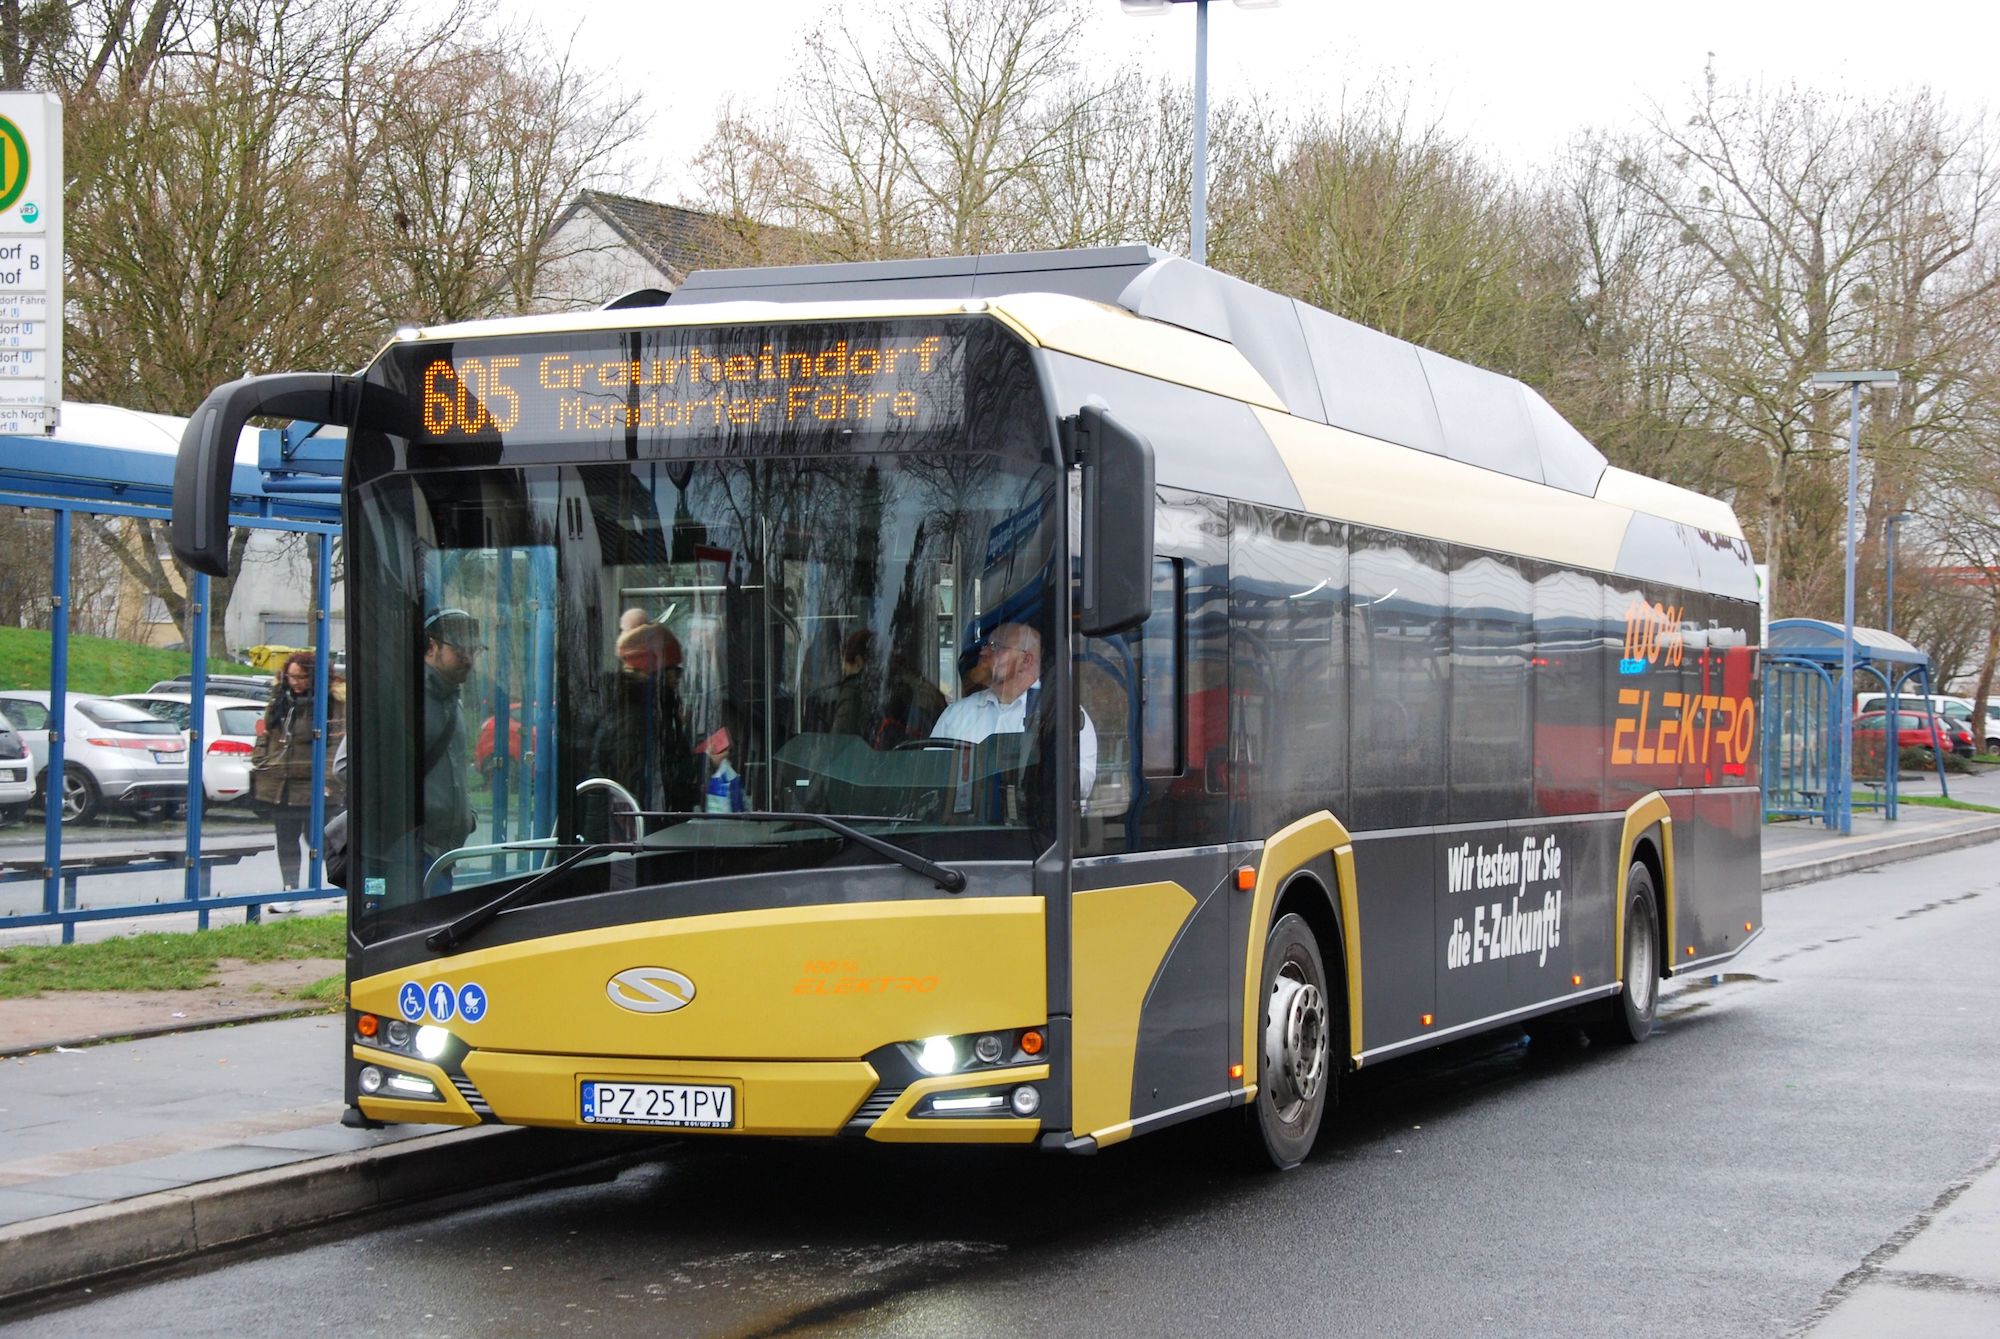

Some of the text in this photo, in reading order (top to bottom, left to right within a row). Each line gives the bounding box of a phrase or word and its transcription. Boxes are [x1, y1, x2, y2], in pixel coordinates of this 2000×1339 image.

[30, 255, 39, 270] B
[540, 336, 939, 388] Graurheindorf
[21, 409, 45, 420] Nord
[424, 358, 519, 435] 605
[788, 384, 916, 422] Fähre
[1624, 598, 1685, 667] 100%
[1611, 689, 1755, 765] ELEKTRO
[1448, 834, 1561, 897] Wir testen für Sie
[1447, 890, 1562, 970] die E-Zukunft!
[792, 976, 939, 994] ELEKTRO
[584, 1104, 594, 1113] PL
[599, 1087, 726, 1118] PZ 251PV
